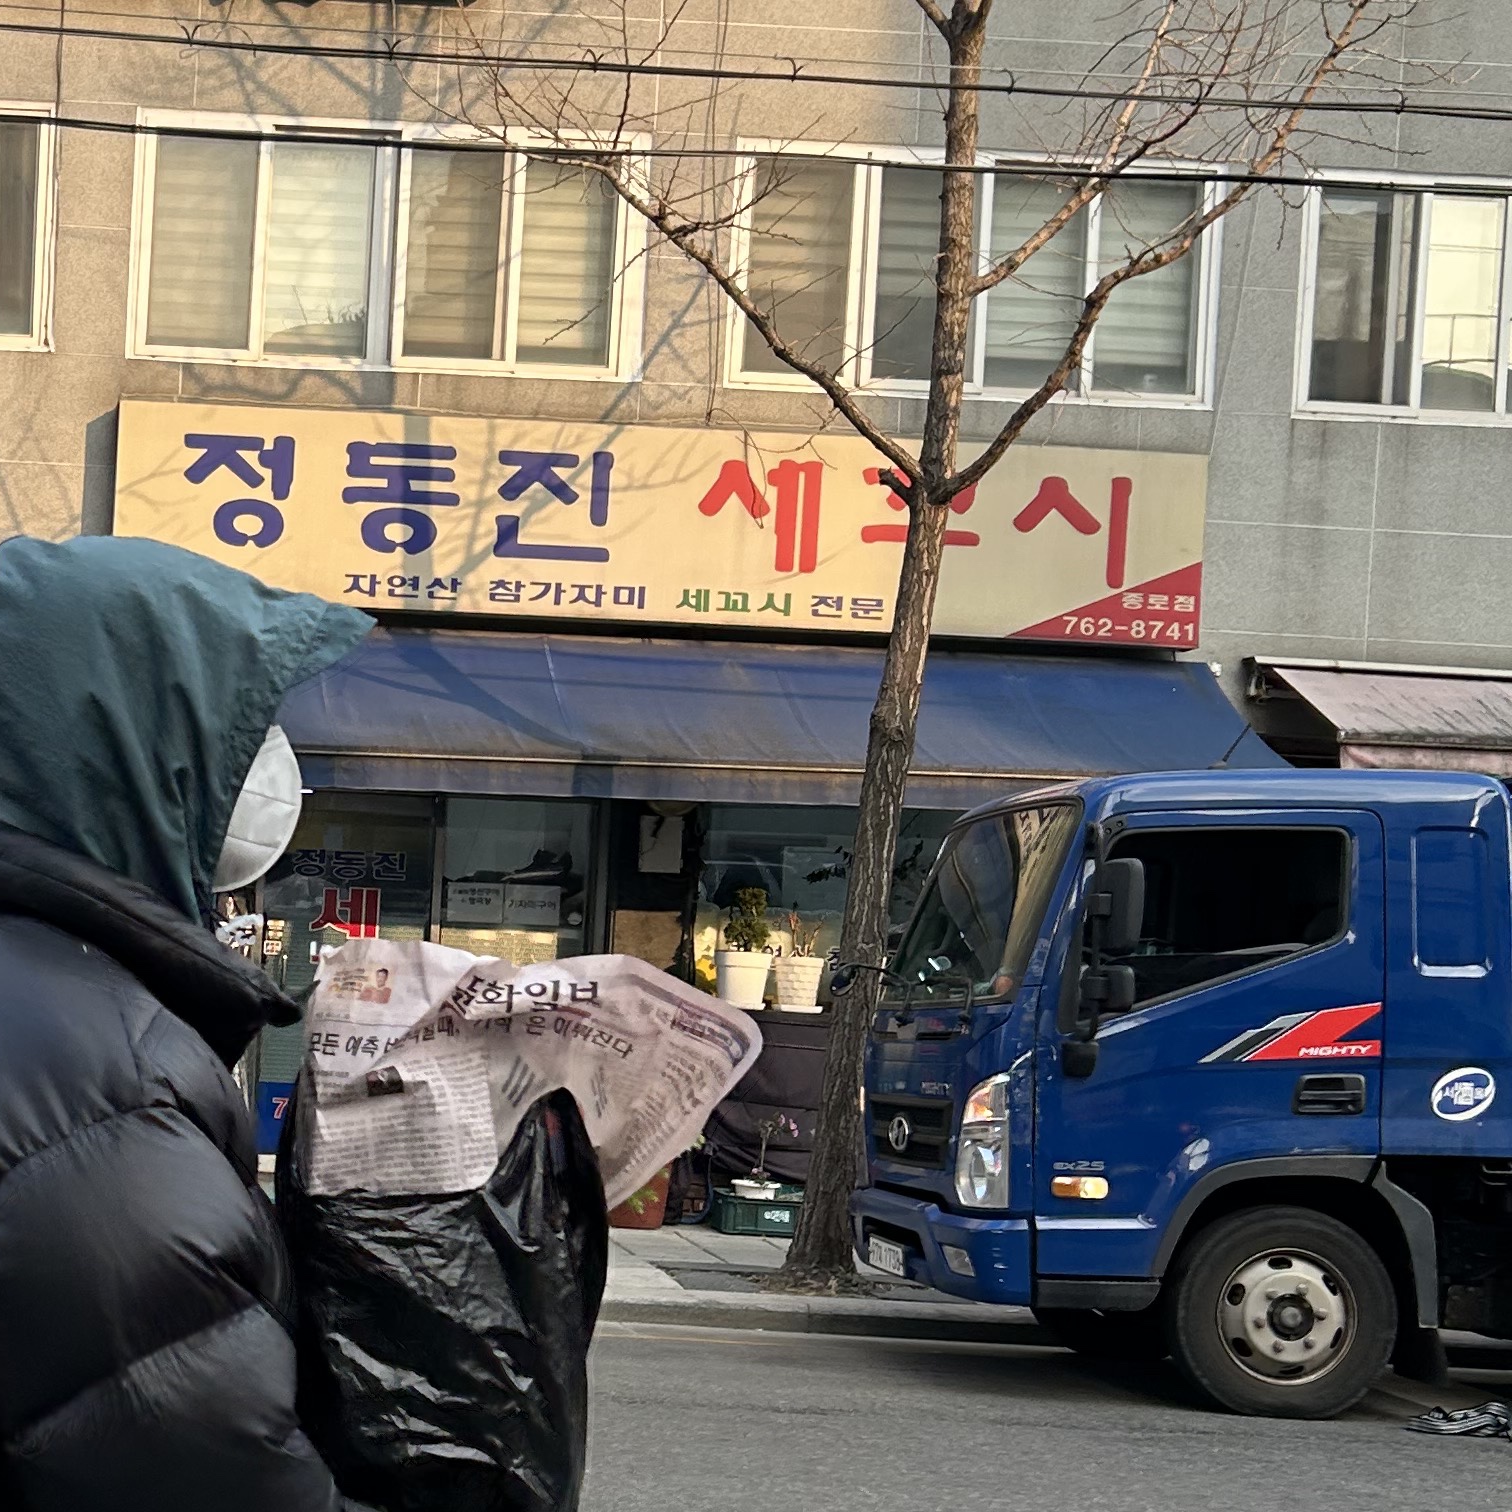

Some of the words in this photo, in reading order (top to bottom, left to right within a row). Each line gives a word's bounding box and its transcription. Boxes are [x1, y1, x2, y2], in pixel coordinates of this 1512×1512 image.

[183, 432, 615, 563] 정동진
[342, 573, 463, 601] 자연산
[488, 578, 647, 610] 참가자미
[675, 588, 792, 617] 세꼬시
[810, 594, 885, 620] 전문
[1062, 615, 1195, 641] 762-8741
[293, 848, 408, 882] 정동진
[308, 886, 382, 940] 세
[310, 1032, 340, 1056] 모든
[345, 1035, 379, 1058] 예측
[1298, 1044, 1373, 1057] MIGHTY
